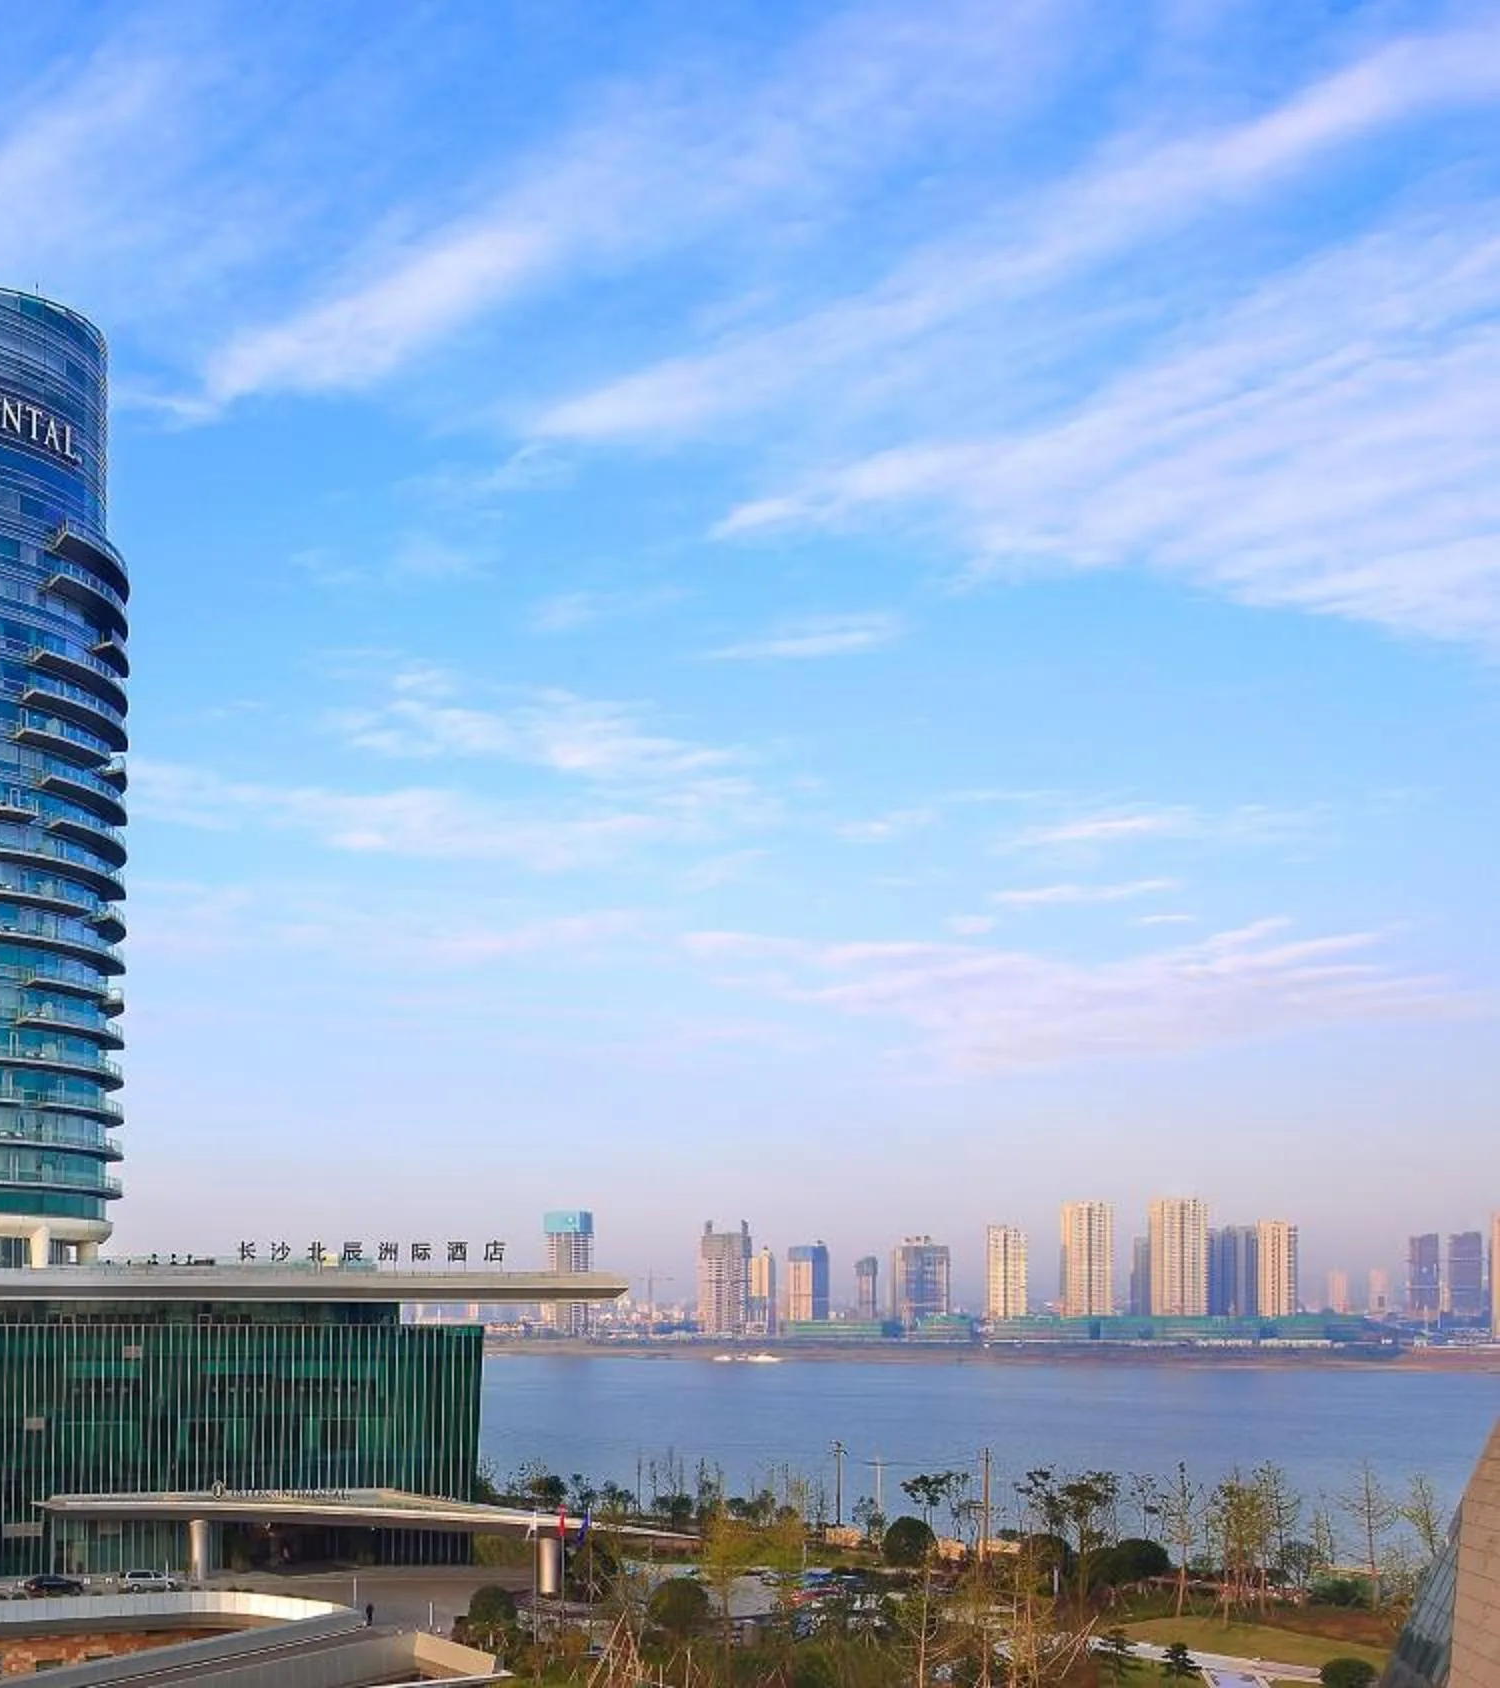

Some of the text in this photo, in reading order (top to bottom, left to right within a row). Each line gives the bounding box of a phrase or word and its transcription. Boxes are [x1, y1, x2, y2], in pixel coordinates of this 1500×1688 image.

[238, 1240, 506, 1263] 长沙北辰洲际酒店
